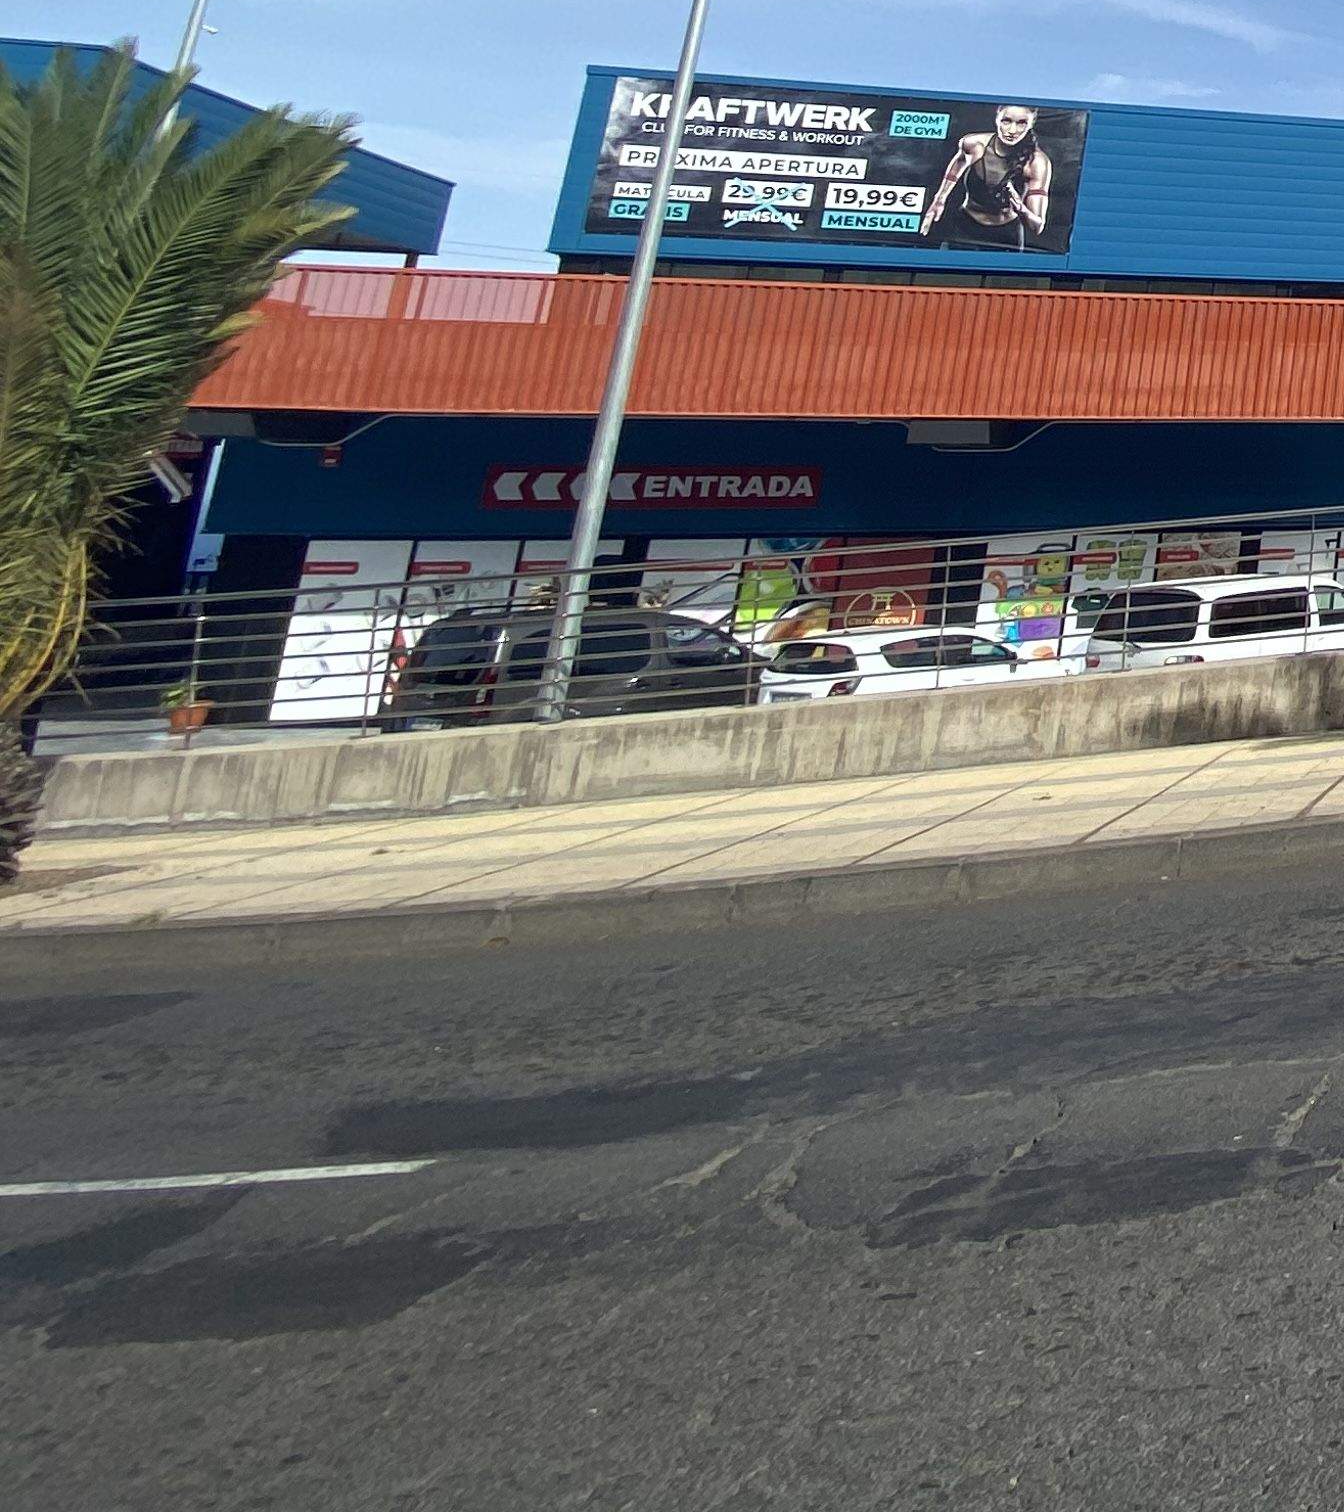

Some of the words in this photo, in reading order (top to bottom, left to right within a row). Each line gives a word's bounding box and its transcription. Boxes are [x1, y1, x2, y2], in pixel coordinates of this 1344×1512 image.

[641, 121, 667, 134] CL
[684, 124, 714, 136] FOR
[717, 126, 777, 141] FITNESS
[779, 130, 788, 142] &
[792, 131, 865, 146] WORKOUT
[894, 125, 911, 136] DE
[914, 126, 943, 137] GYM
[627, 150, 733, 169] PRXIMA
[741, 158, 860, 176] APERTURA
[618, 186, 706, 200] MATCULA
[727, 184, 808, 202] 2999€
[833, 187, 919, 209] 19,99€
[613, 202, 684, 218] GRIS
[722, 208, 804, 225] MENSUAL
[827, 214, 915, 230] MENSUAL
[642, 475, 814, 498] ENTRADA
